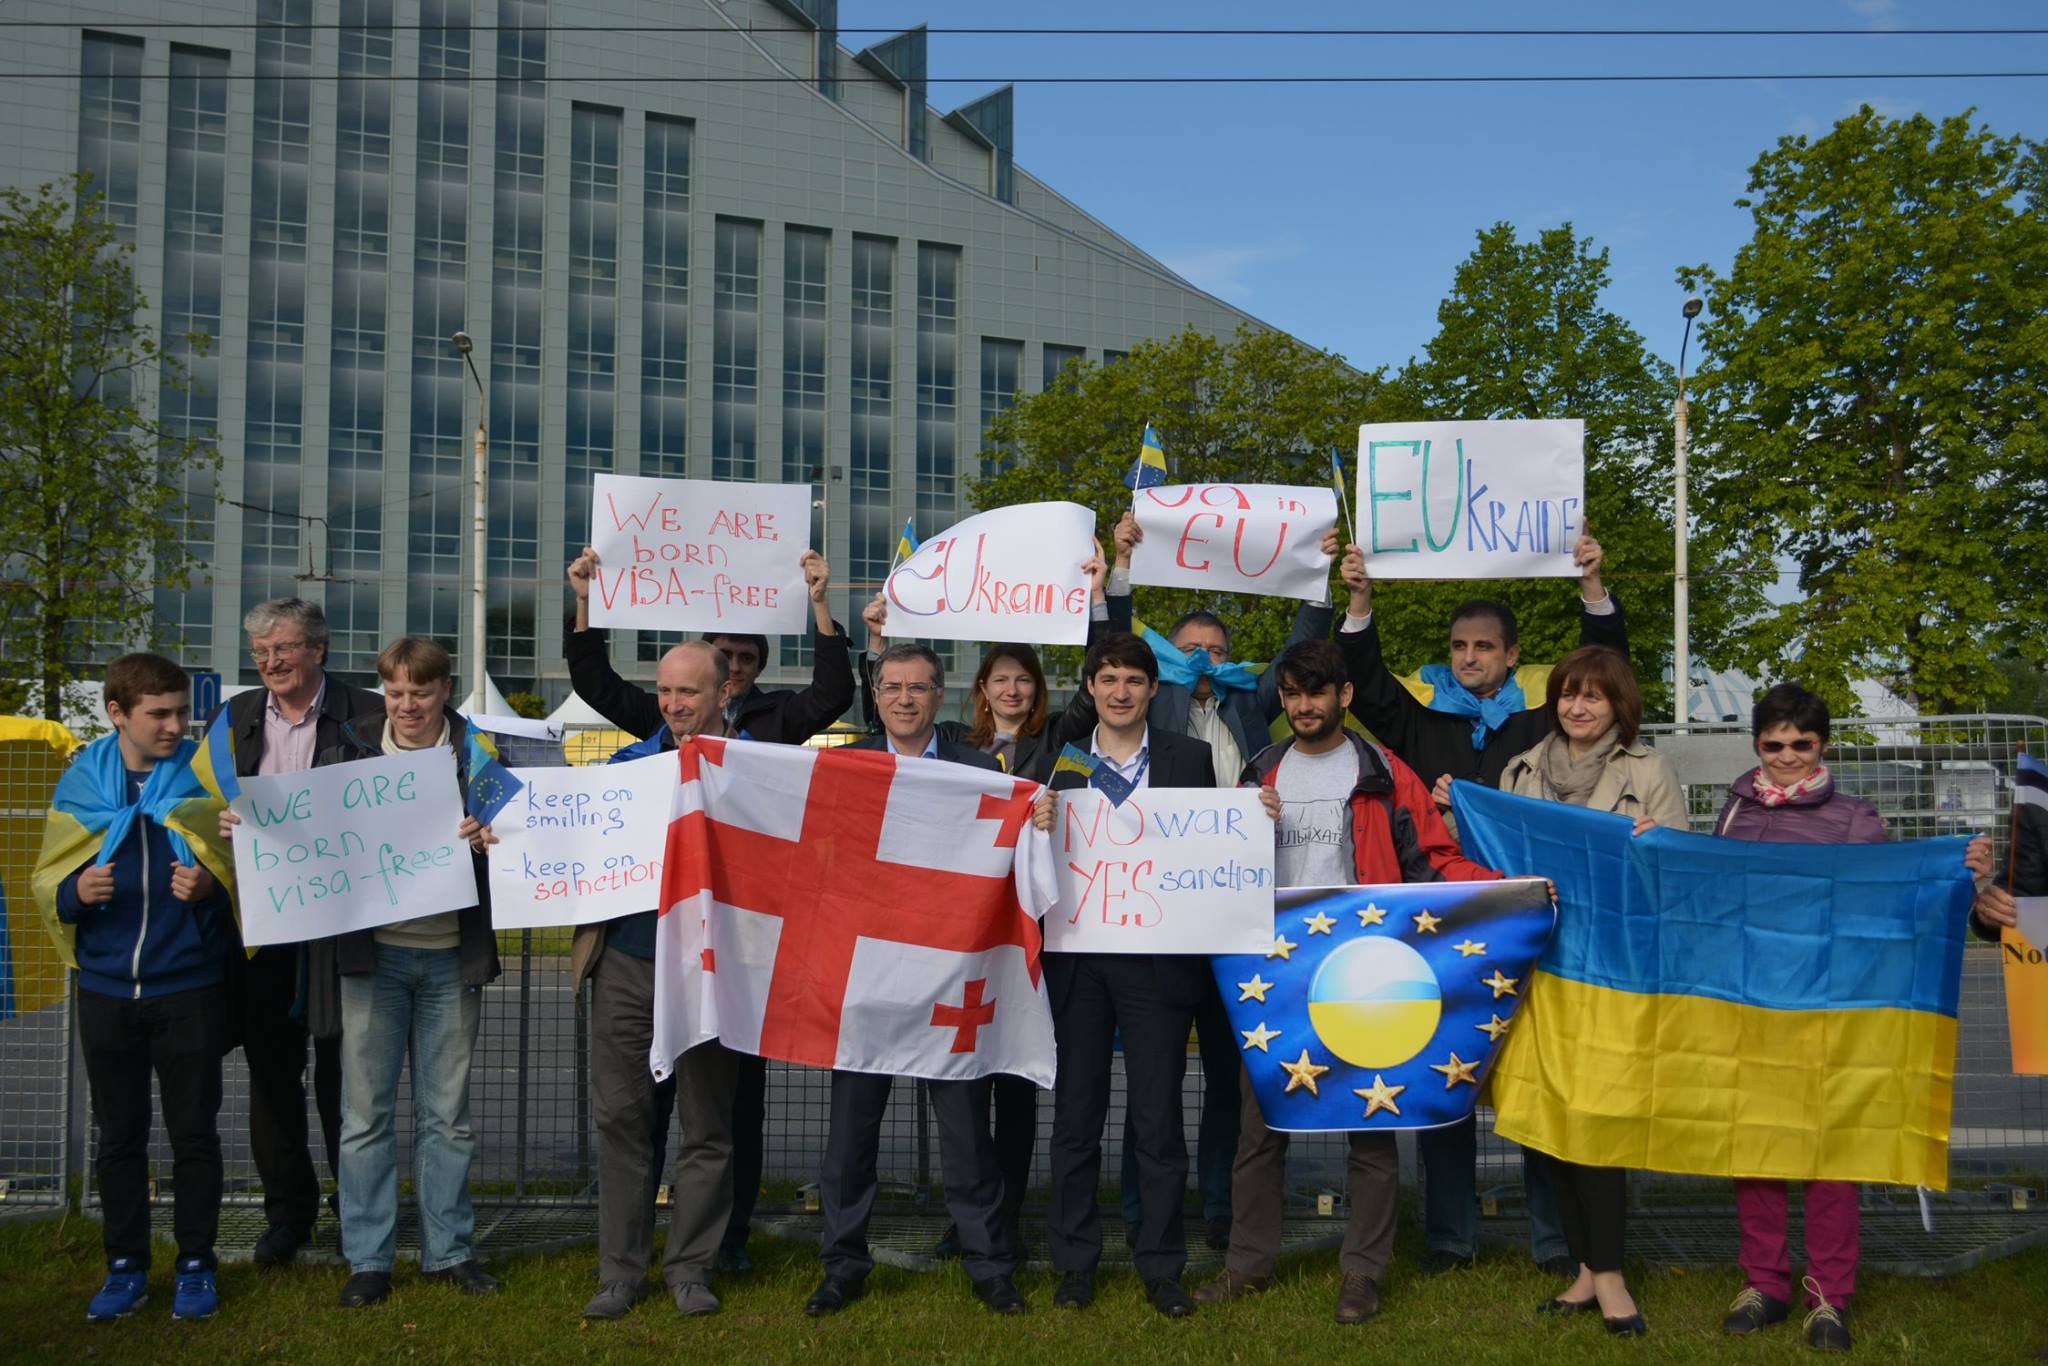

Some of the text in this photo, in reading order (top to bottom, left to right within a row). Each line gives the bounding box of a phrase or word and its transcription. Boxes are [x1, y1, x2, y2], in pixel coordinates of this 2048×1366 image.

[608, 491, 778, 541] WE ARE
[1278, 496, 1306, 516] in
[1176, 512, 1288, 578] EU
[528, 781, 591, 823] keep
[602, 789, 633, 803] on
[1064, 799, 1145, 853] NO
[523, 852, 585, 891] keep
[604, 854, 635, 870] on
[534, 861, 664, 900] sanction
[1068, 859, 1273, 927] YES sanction
